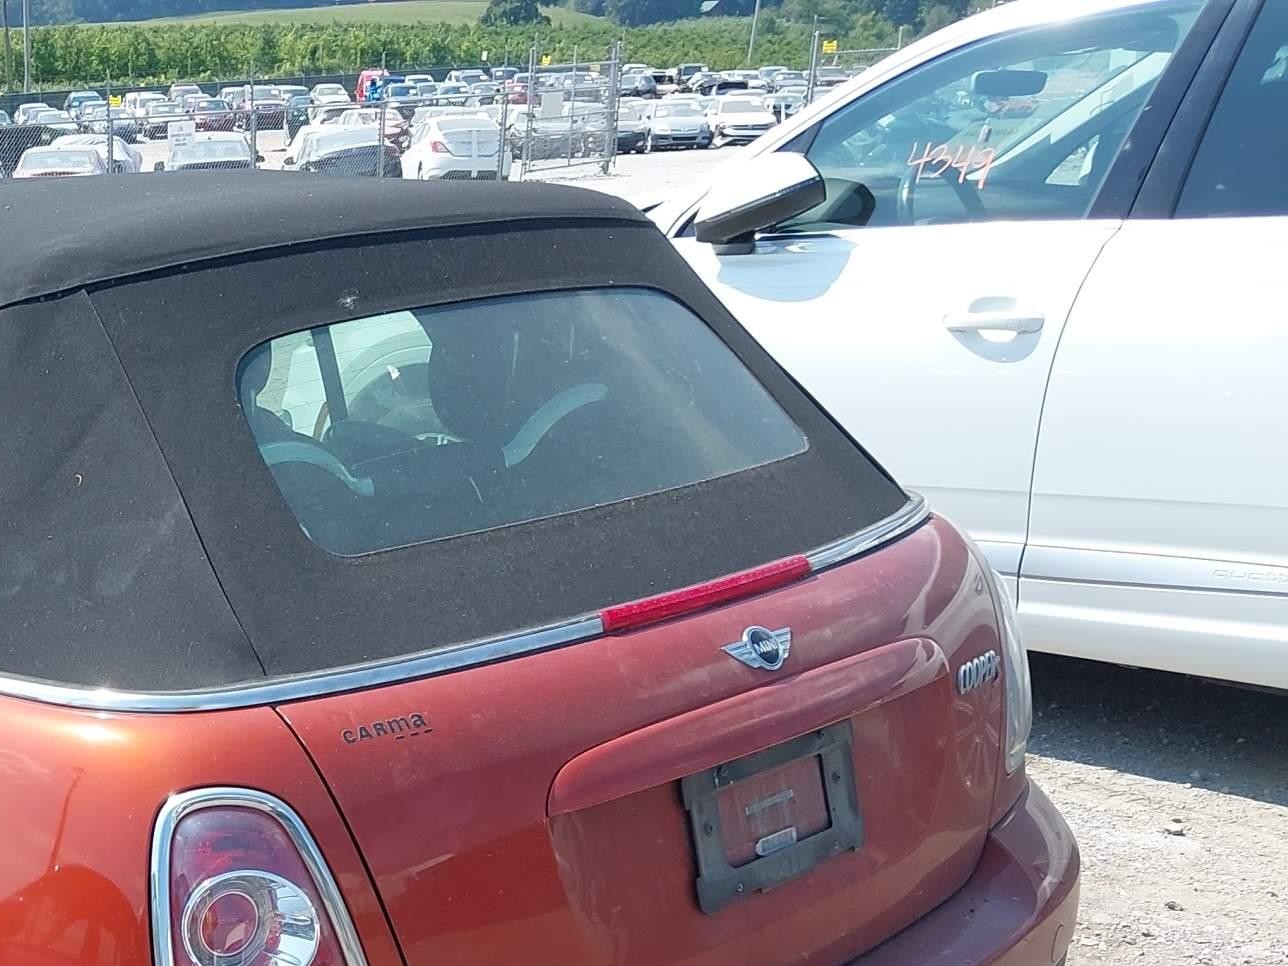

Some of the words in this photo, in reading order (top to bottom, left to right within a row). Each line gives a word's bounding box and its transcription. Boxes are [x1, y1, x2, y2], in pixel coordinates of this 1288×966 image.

[907, 142, 994, 189] 4349
[754, 639, 778, 654] MINI
[958, 650, 995, 695] COOPER
